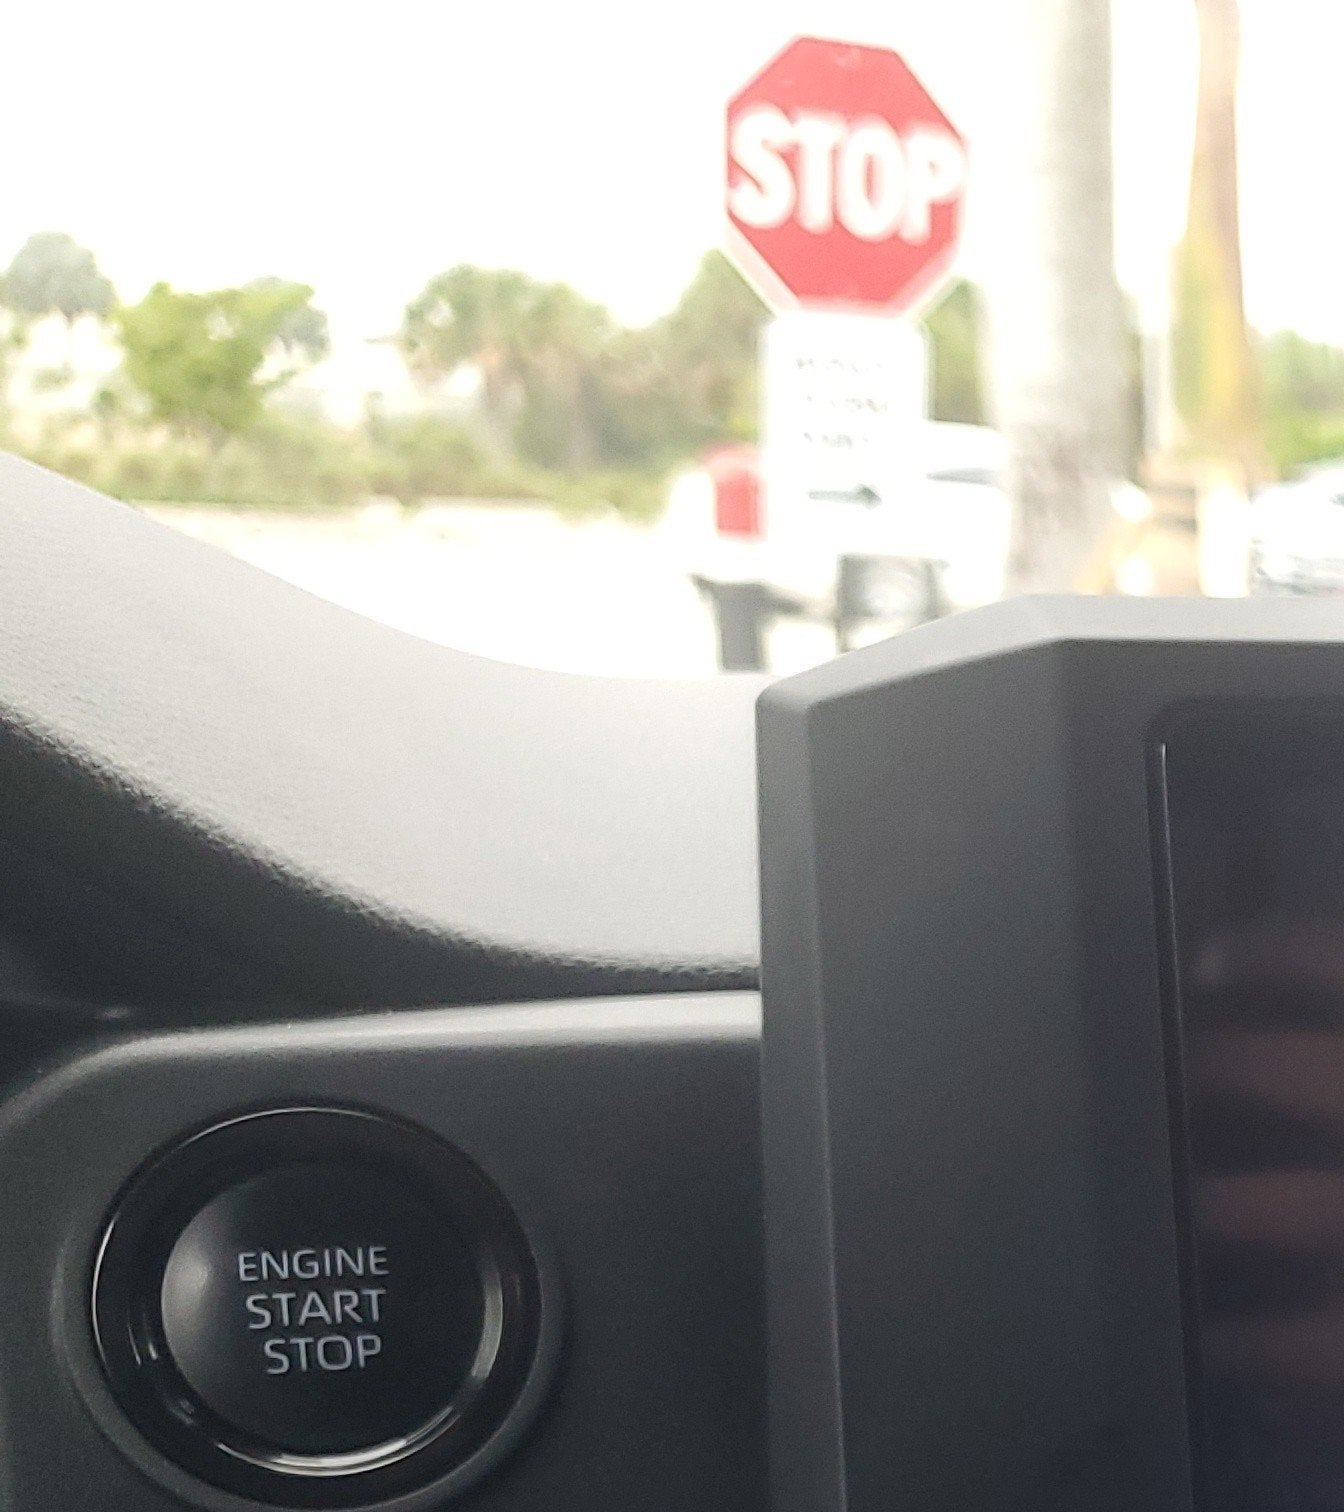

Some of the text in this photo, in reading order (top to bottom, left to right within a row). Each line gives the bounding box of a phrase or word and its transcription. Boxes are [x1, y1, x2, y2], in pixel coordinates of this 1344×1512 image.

[728, 102, 966, 244] STOP
[238, 1245, 389, 1283] ENGINE
[245, 1288, 387, 1330] START
[263, 1334, 382, 1375] STOP
